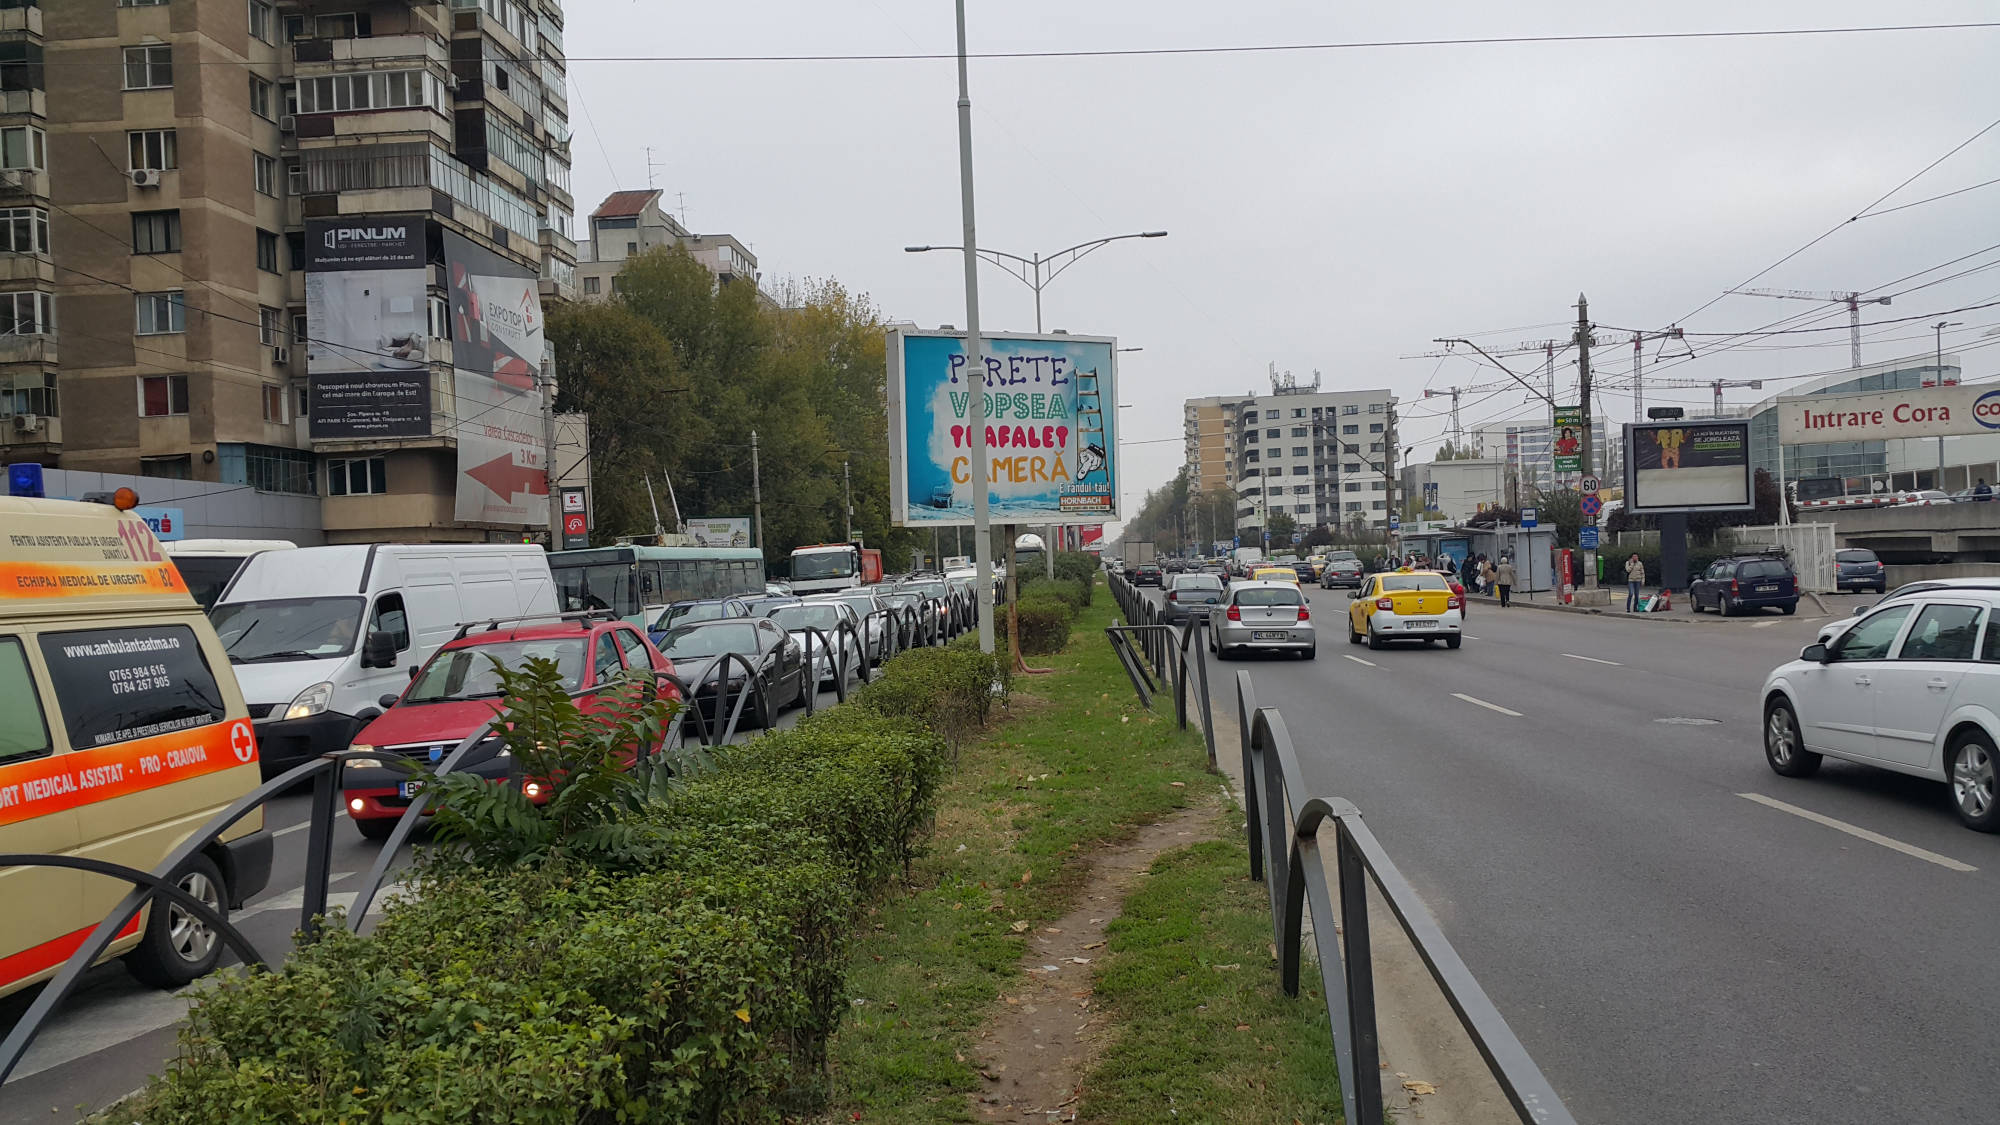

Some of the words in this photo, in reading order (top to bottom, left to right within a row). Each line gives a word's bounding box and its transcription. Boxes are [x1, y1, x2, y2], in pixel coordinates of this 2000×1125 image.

[338, 227, 405, 240] PINUM
[489, 302, 508, 322] EXPO
[509, 310, 522, 326] TOP
[948, 353, 1069, 387] PRETE
[1804, 408, 1884, 429] Intrare
[1893, 403, 1950, 423] Cora
[521, 448, 526, 464] 3
[951, 450, 1070, 484] CMERĂ
[1067, 481, 1091, 493] rândul
[1583, 479, 1596, 491] 60
[1061, 496, 1102, 505] HORNBACH
[9, 535, 35, 547] PENTRU
[37, 535, 67, 547] ASISTENTA
[68, 535, 91, 547] PUBLICA
[91, 535, 100, 547] DE
[117, 519, 163, 562] 112
[16, 575, 57, 588] ECHIPAJ
[59, 575, 97, 587] MEDICAL
[98, 575, 108, 586] DE
[110, 574, 147, 586] URGENTA
[159, 567, 174, 587] B2
[63, 636, 180, 659] www.ambulantaatma.ro
[109, 667, 132, 682] 0765
[132, 665, 149, 679] 984
[150, 663, 166, 676] 616
[112, 680, 135, 695] 0784
[137, 678, 152, 692] 267
[153, 675, 170, 689] 905
[22, 773, 78, 802] MEDICAL
[79, 763, 124, 789] ASISTAT
[139, 754, 161, 775] PRO
[166, 745, 207, 769] CRAIOVA
